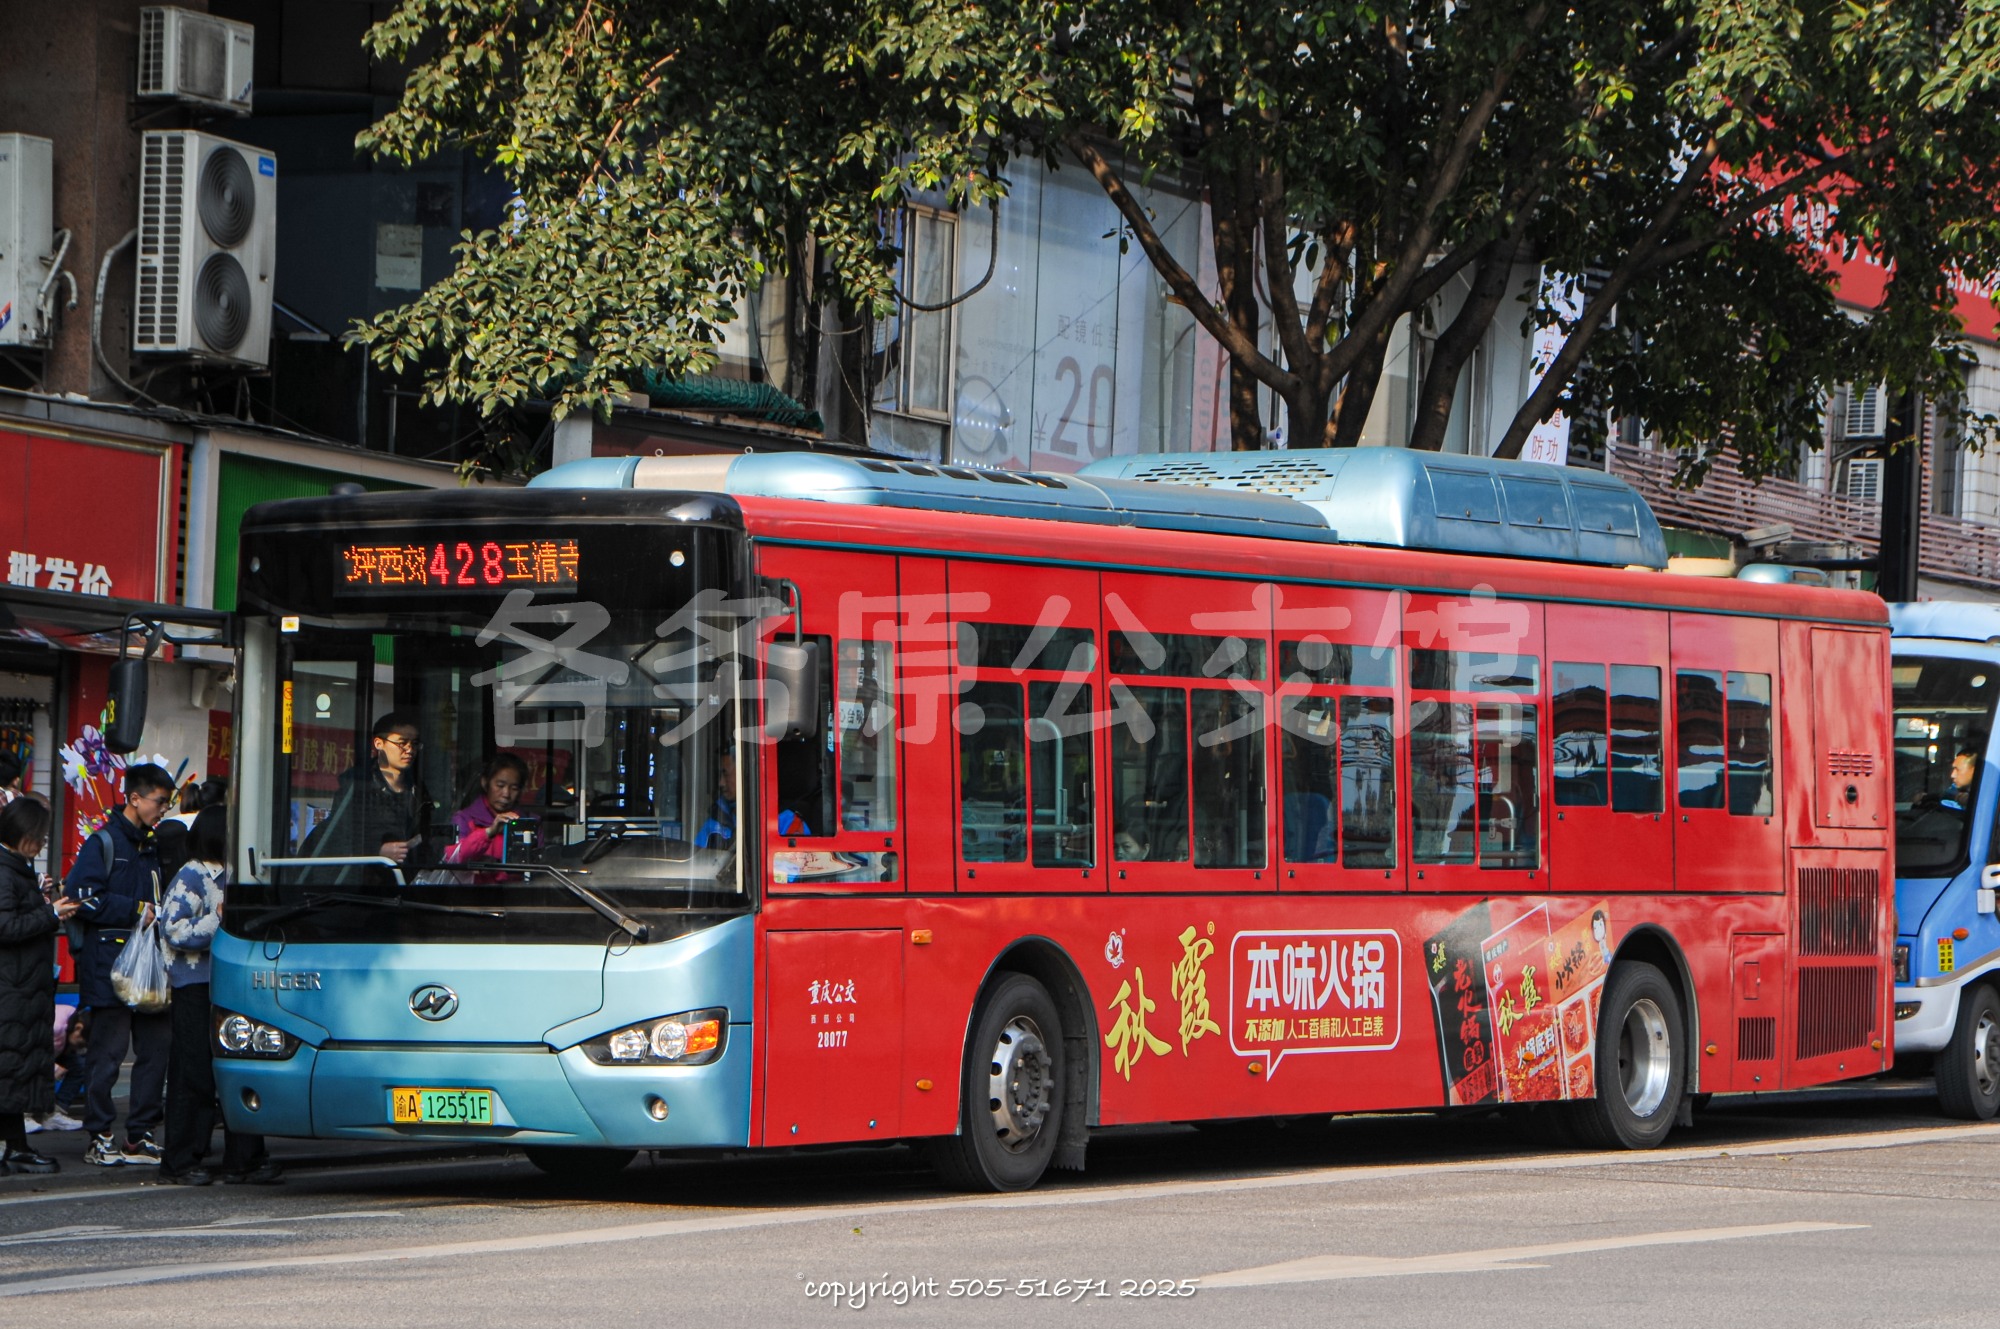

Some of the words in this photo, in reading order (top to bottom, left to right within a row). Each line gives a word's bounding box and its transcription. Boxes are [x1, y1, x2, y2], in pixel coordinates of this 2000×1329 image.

[7, 551, 113, 597] 批发价
[430, 542, 504, 585] 428
[252, 970, 322, 990] HIGER
[808, 978, 857, 1005] 重庆公交
[1245, 939, 1385, 1012] 本味火锅
[817, 1030, 848, 1049] 28077
